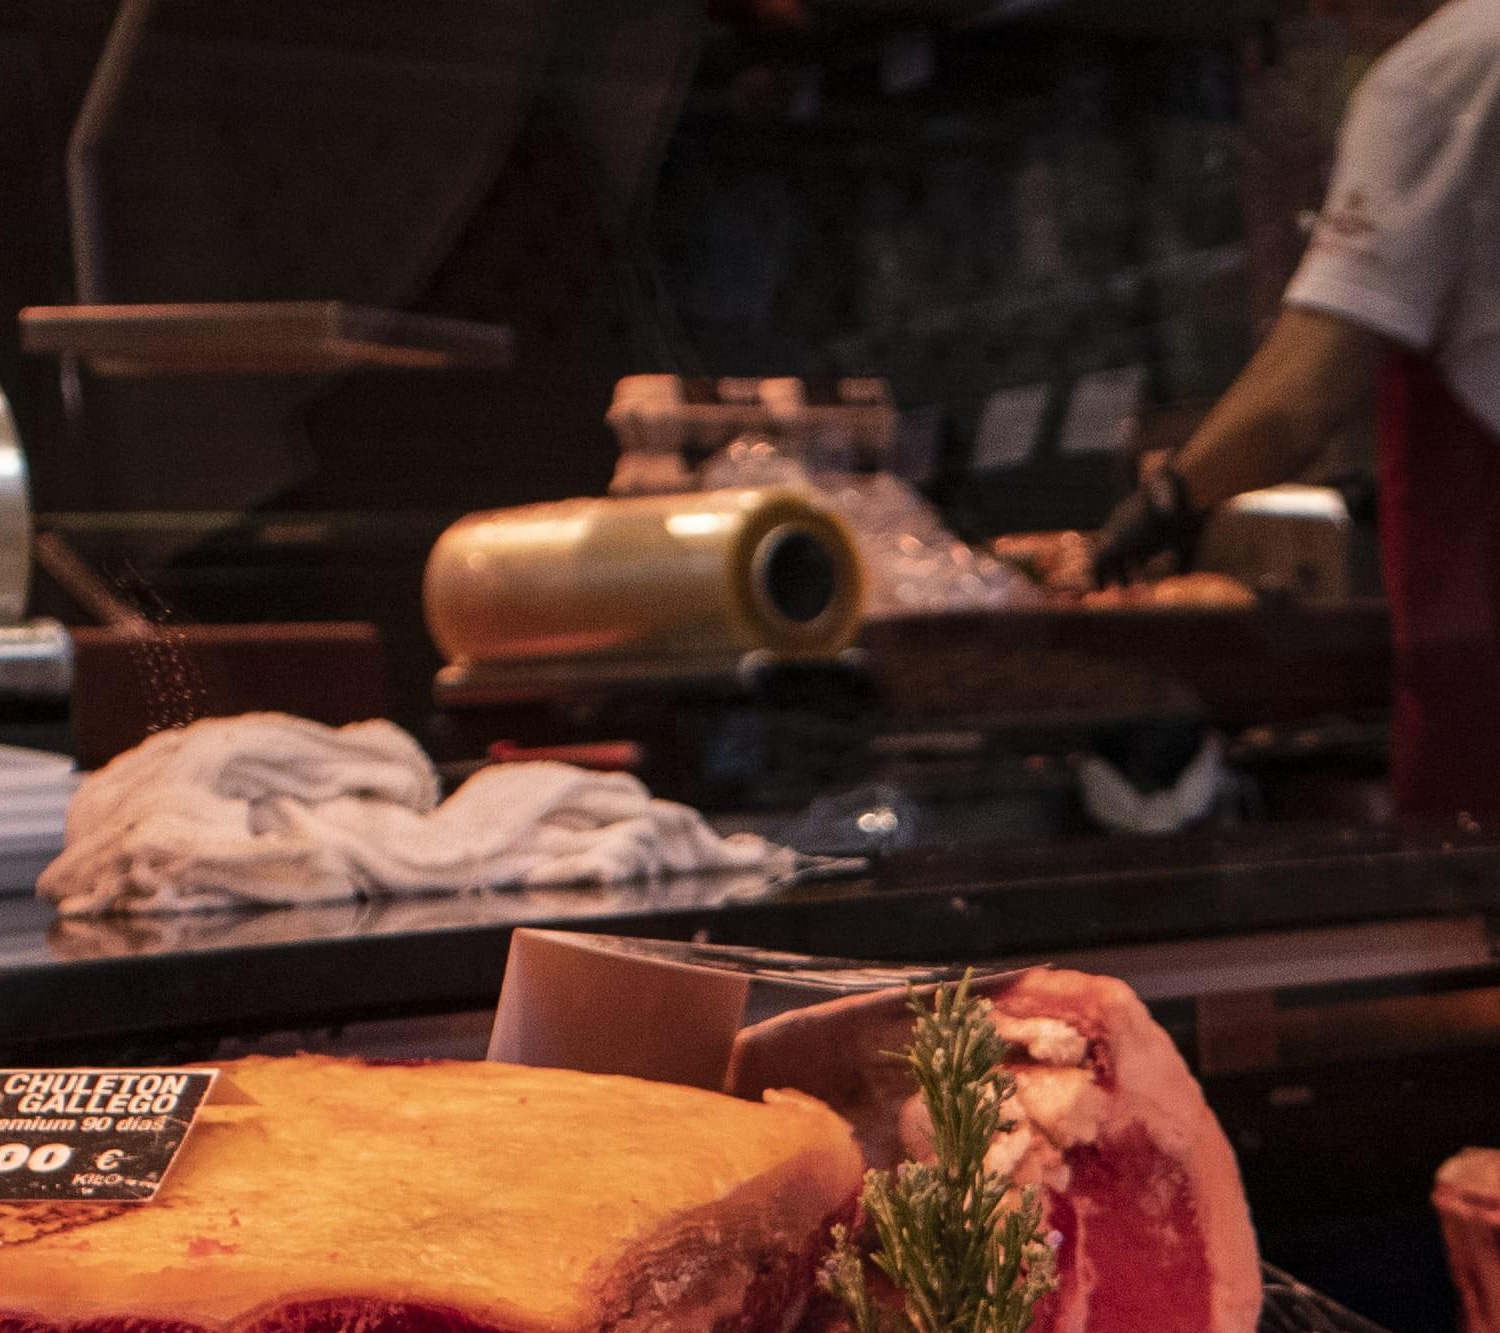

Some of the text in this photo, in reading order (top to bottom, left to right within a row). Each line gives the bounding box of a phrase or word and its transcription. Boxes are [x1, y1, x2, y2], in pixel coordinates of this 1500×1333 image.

[3, 1074, 189, 1096] CHULETON
[17, 1093, 179, 1114] GALLEGO
[80, 1115, 112, 1132] 90
